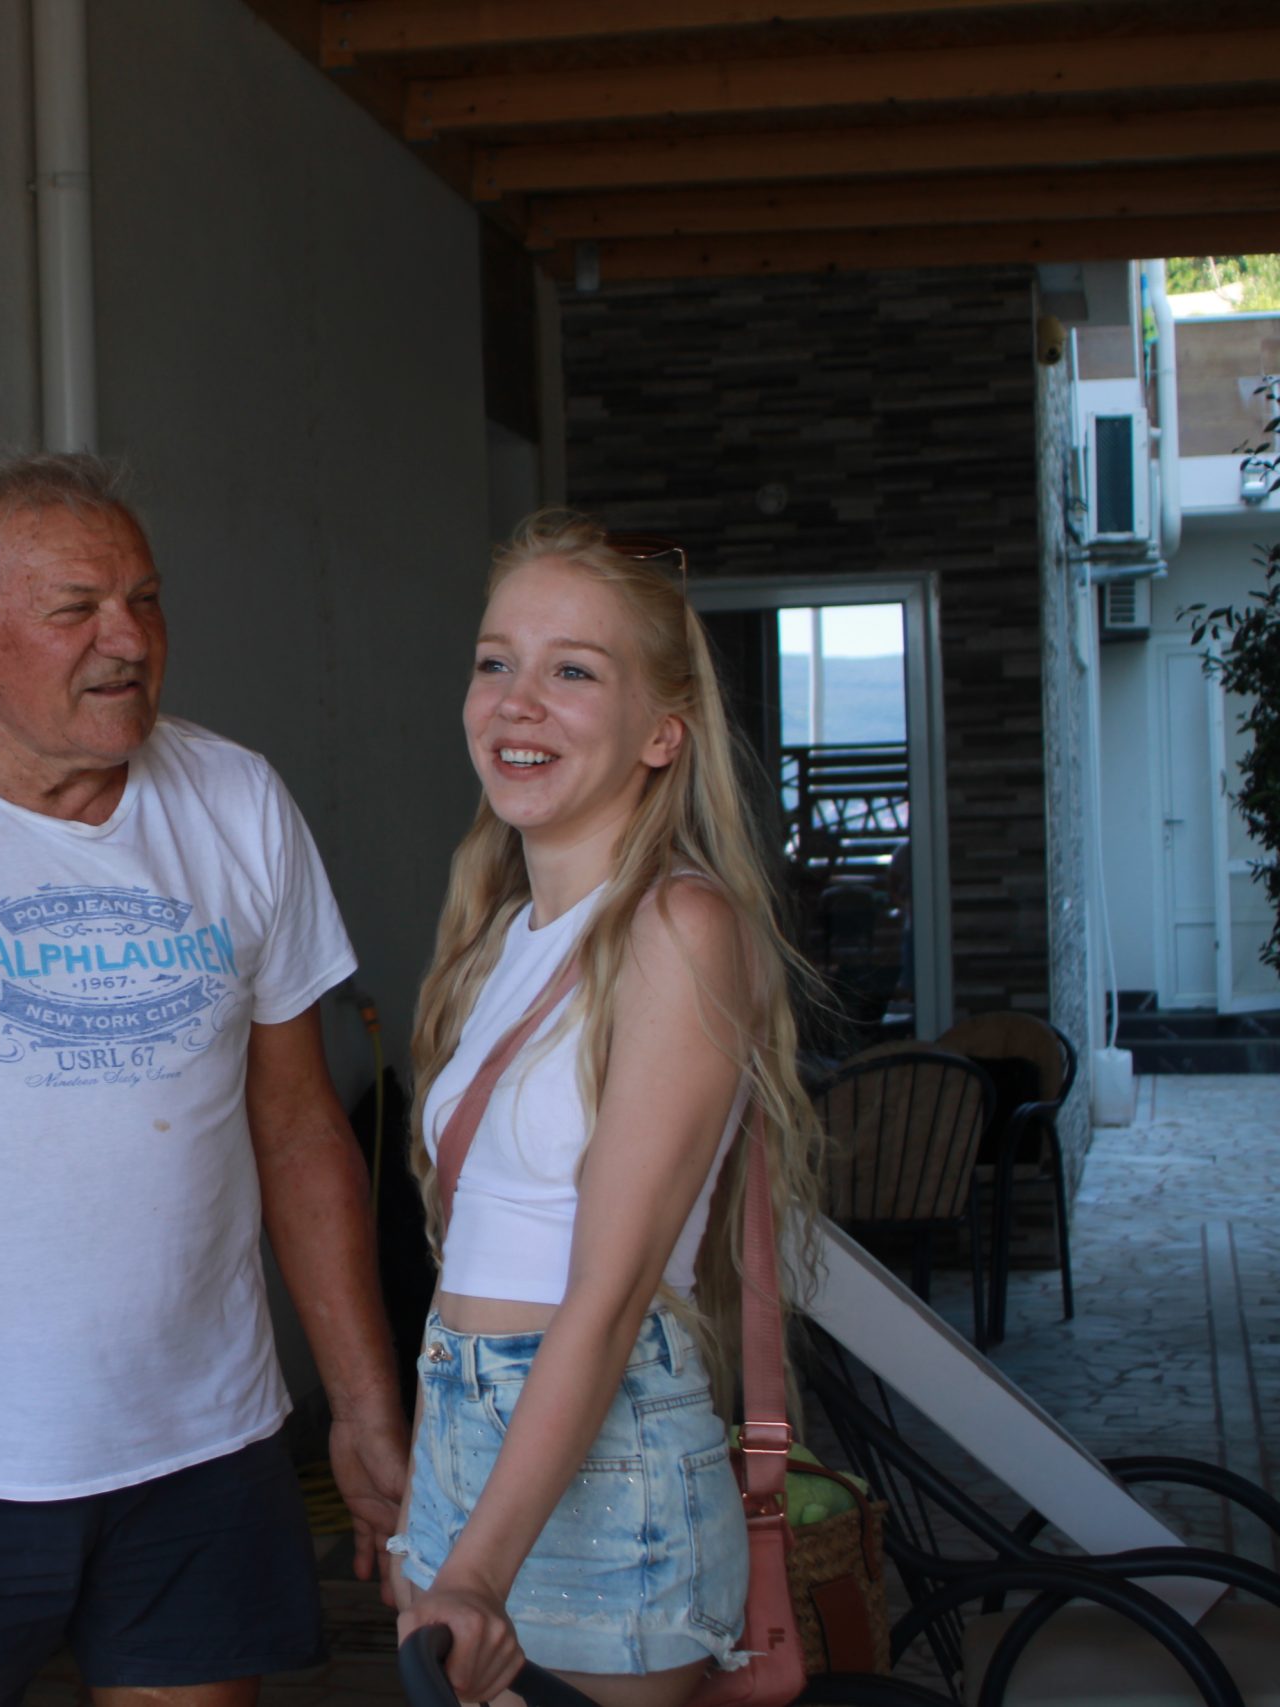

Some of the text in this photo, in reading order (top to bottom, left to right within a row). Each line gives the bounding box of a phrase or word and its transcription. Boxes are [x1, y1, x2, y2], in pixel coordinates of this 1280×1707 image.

[13, 899, 180, 925] POLO JEANS CO.
[26, 995, 192, 1030] NEW YORK CITY
[56, 1046, 156, 1071] USRL 67
